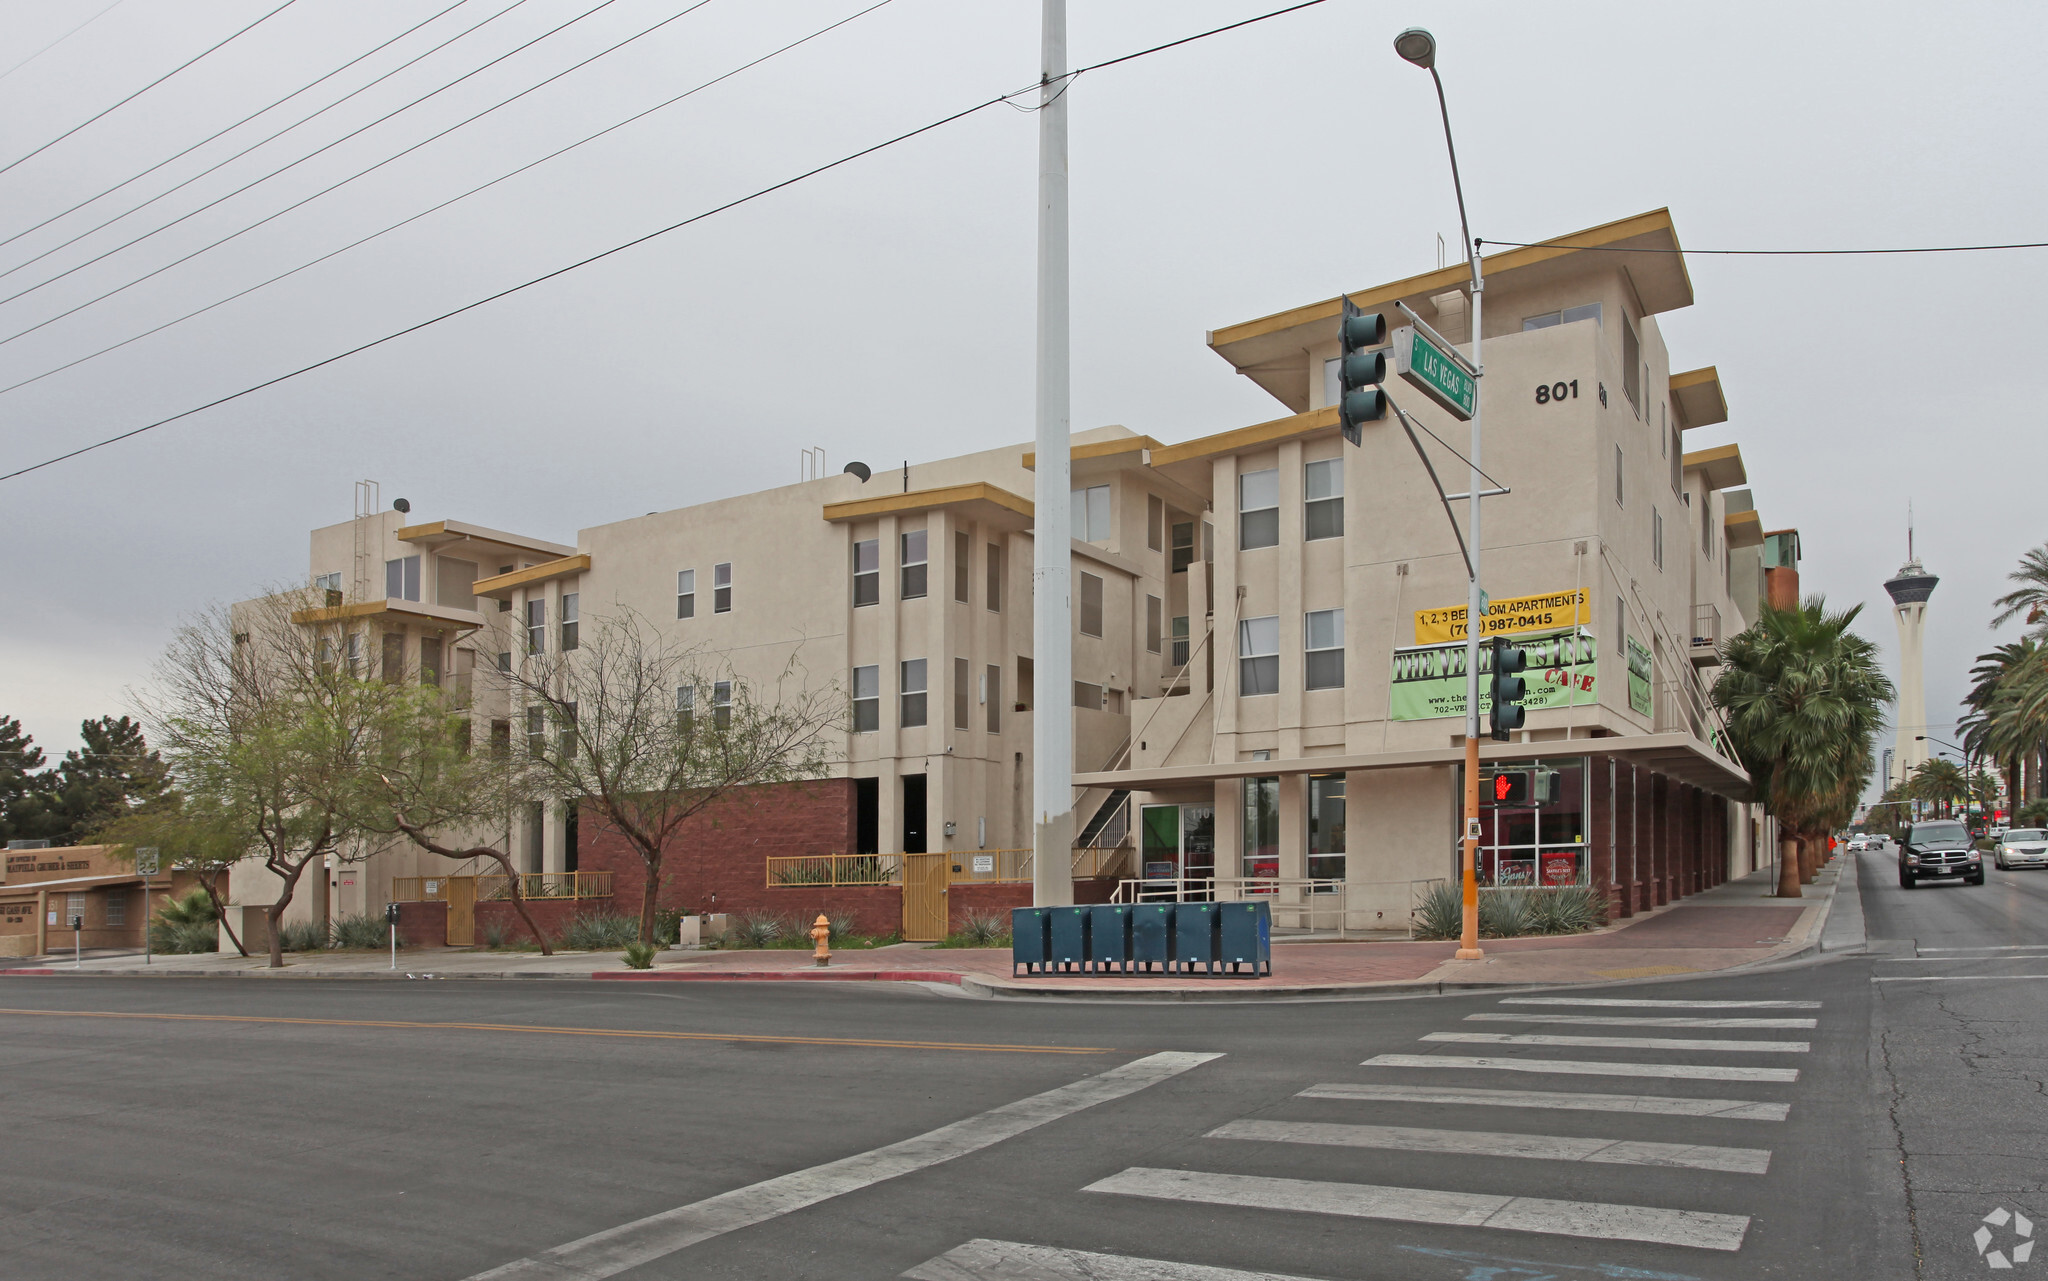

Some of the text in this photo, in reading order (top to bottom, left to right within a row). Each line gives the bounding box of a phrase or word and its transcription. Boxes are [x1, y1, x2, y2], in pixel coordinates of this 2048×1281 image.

[1414, 338, 1419, 351] S
[1424, 351, 1460, 395] LAS VEGAS
[1463, 378, 1473, 395] BLVD
[1535, 379, 1578, 405] 801
[1420, 615, 1428, 627] 1,
[1431, 613, 1439, 625] 2,
[1442, 612, 1449, 622] 3
[1508, 593, 1585, 614] APARTMENTS
[1488, 613, 1553, 631] 987-0415
[1393, 651, 1435, 680] THE
[1551, 633, 1594, 670] INN
[1544, 668, 1596, 693] CAFE
[1191, 808, 1210, 819] 110
[139, 863, 157, 873] 25
